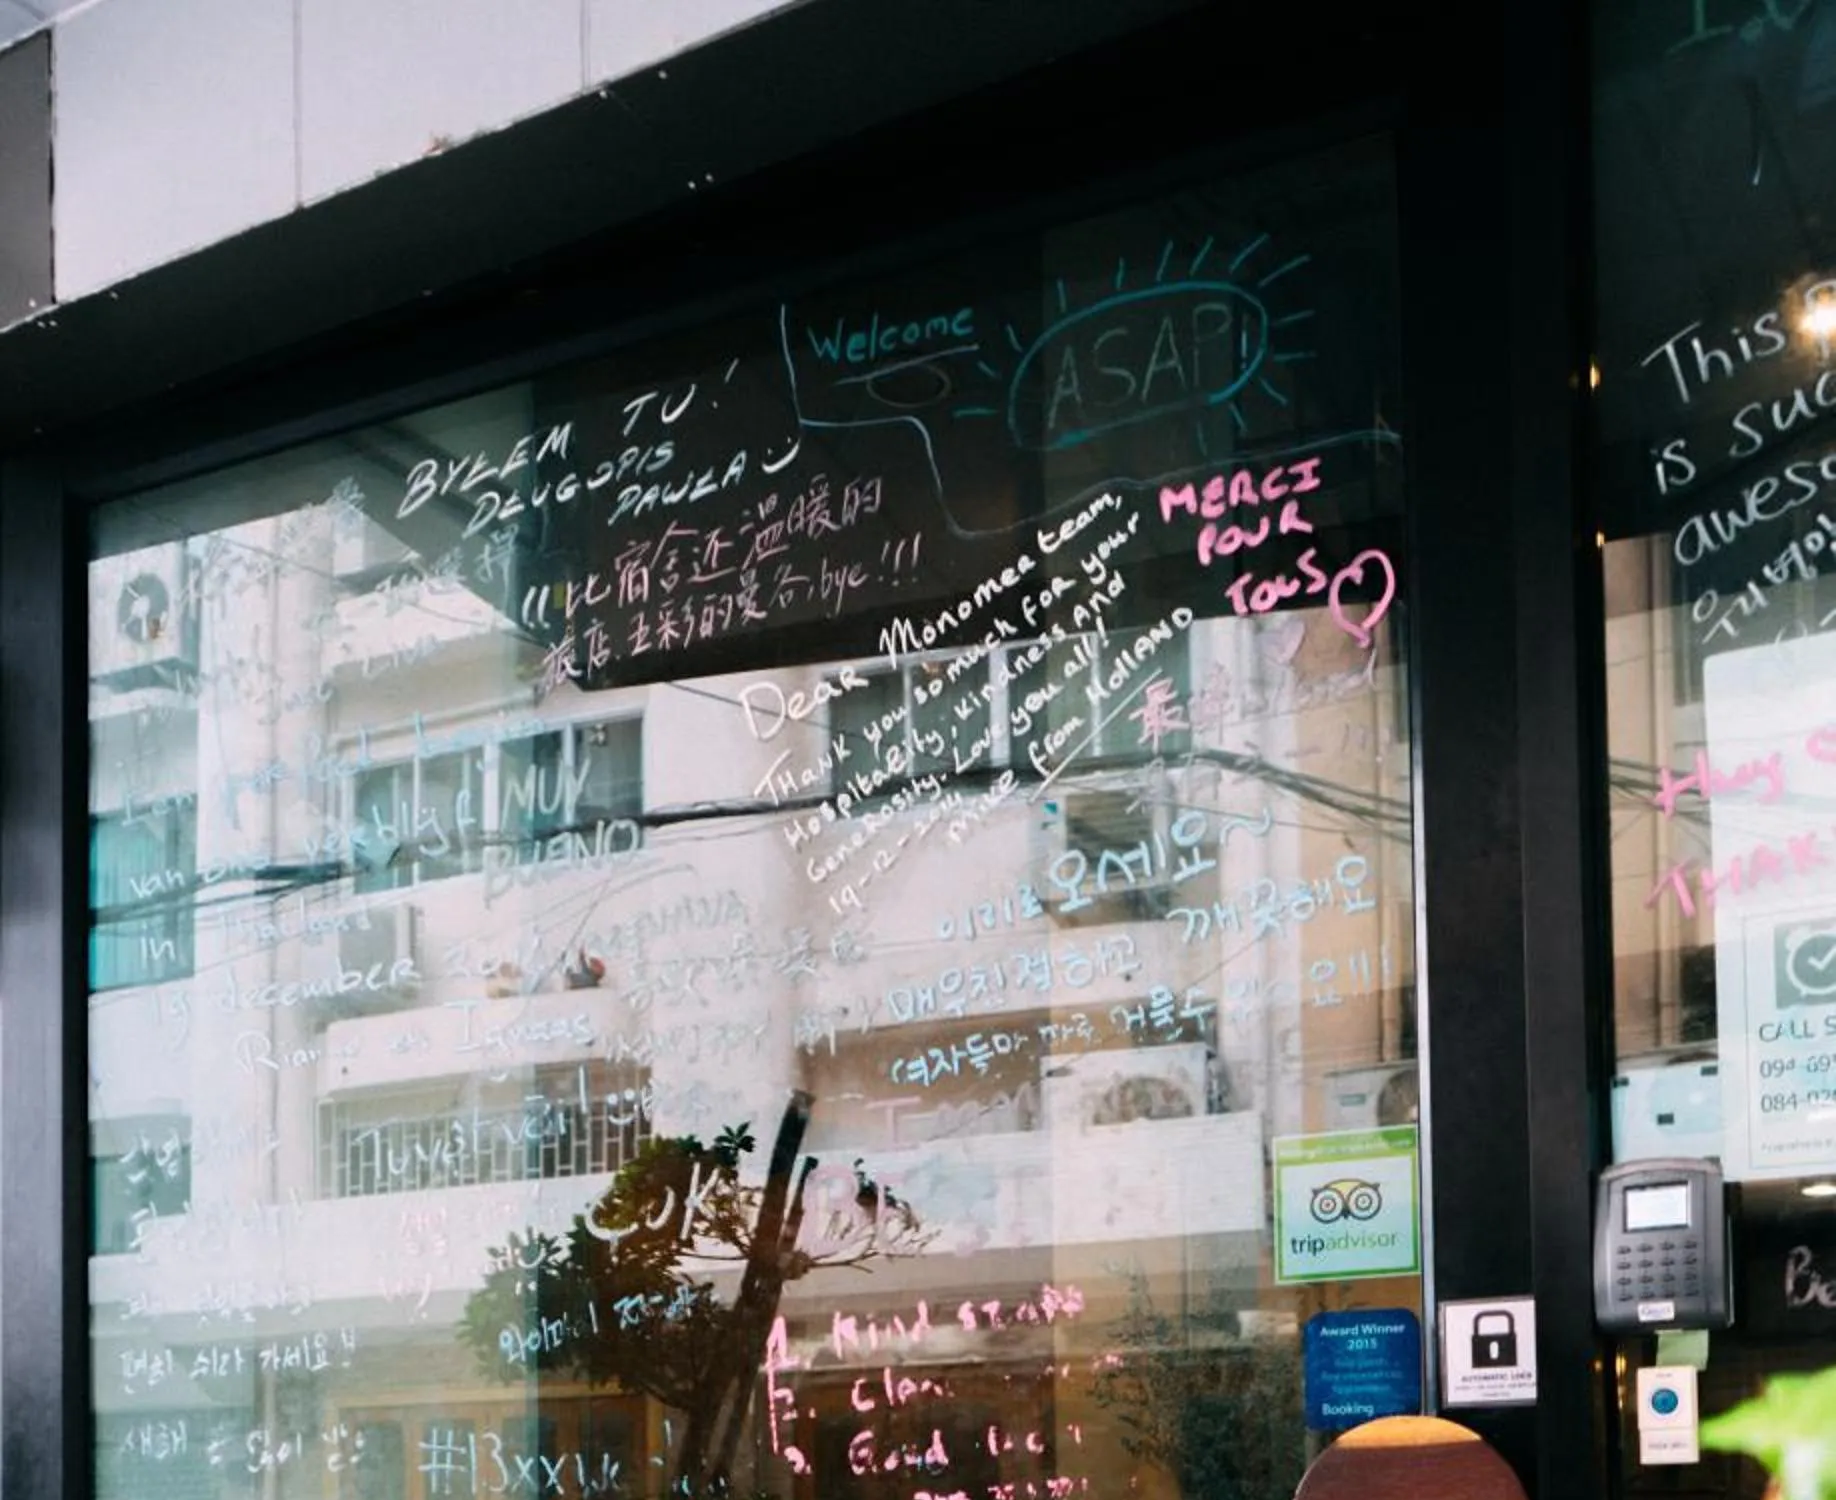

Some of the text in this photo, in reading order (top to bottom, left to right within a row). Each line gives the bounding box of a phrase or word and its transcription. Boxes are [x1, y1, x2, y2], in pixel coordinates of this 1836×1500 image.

[807, 306, 974, 364] Welcome
[1641, 310, 1787, 404] This
[1160, 458, 1322, 524] MERCI
[1651, 437, 1698, 495] is
[1197, 501, 1314, 566] POUR
[862, 703, 910, 760] you
[913, 677, 944, 707] so
[946, 620, 1019, 684] much
[1080, 512, 1139, 586] your
[952, 719, 1004, 776] Love
[1010, 682, 1066, 738] you
[501, 755, 592, 832] MUY
[212, 955, 421, 1014] december
[1758, 1018, 1815, 1043] CALL
[1291, 1230, 1399, 1257] tripadvisor
[1320, 1322, 1407, 1338] Award Winner
[1321, 1402, 1375, 1418] Booking
